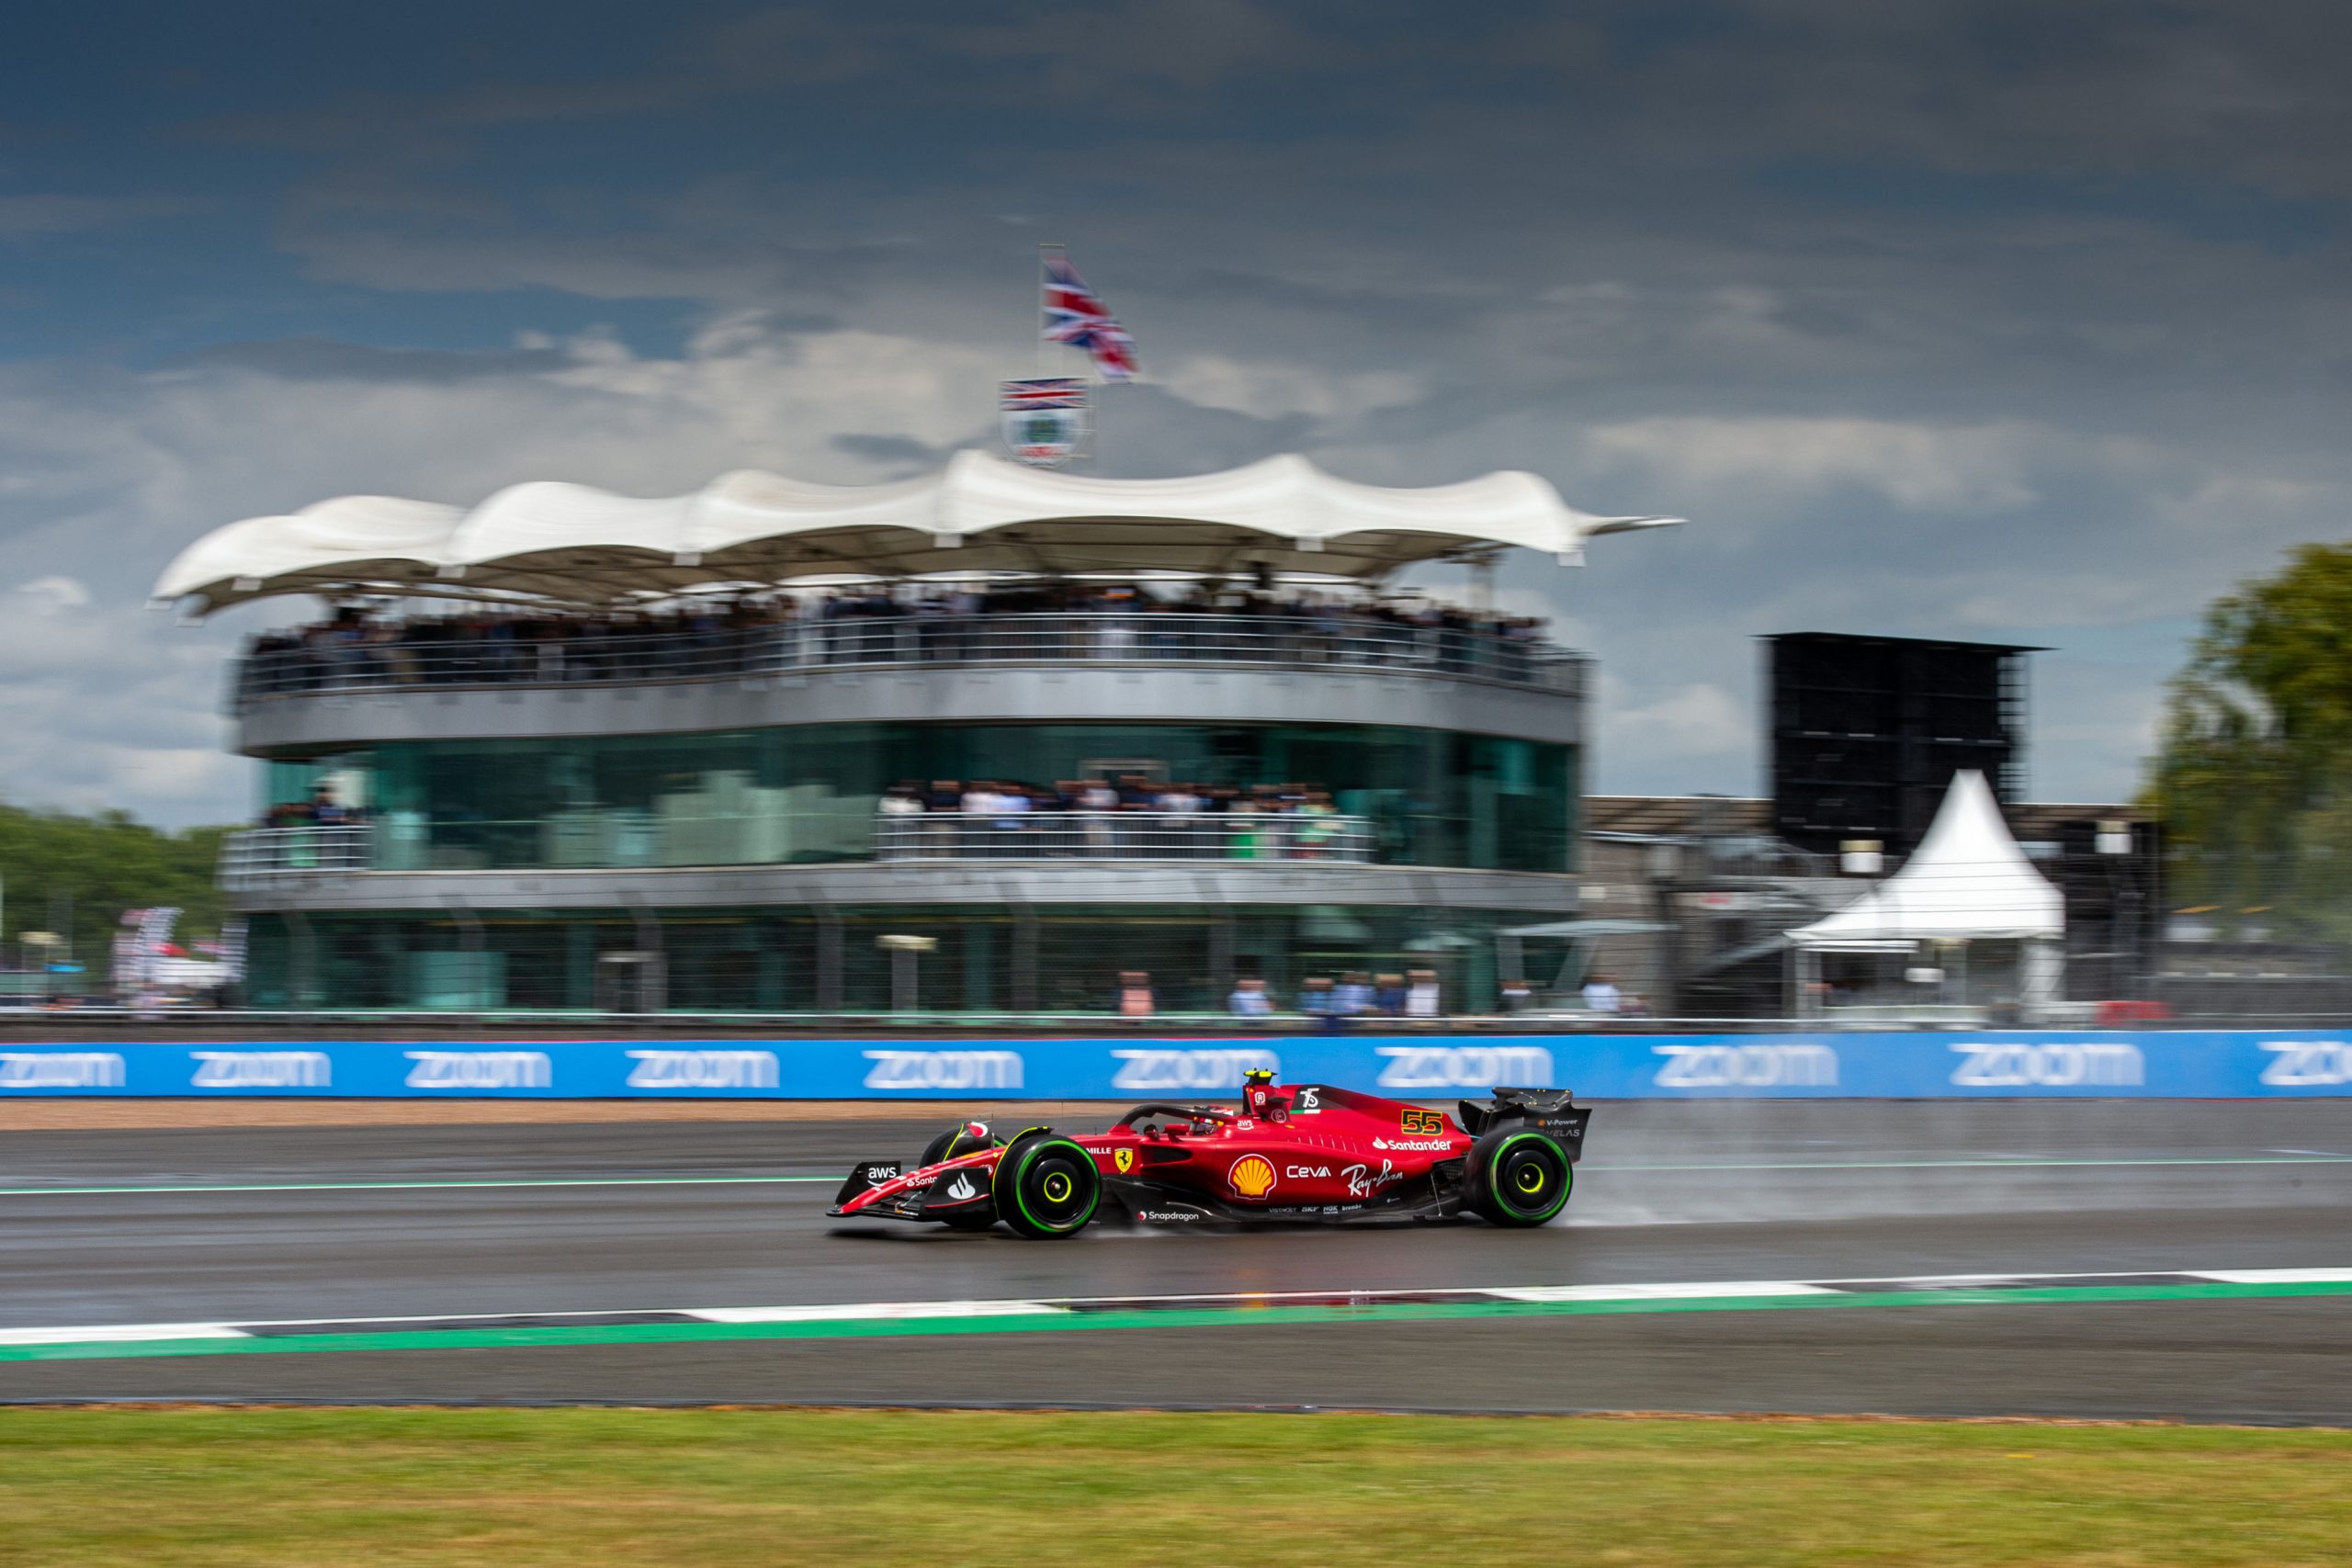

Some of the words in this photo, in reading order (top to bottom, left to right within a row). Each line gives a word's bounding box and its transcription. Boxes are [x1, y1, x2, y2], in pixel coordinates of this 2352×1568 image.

[190, 1052, 332, 1088] zoom
[404, 1052, 549, 1088] zoom
[626, 1051, 779, 1089] zoom
[863, 1050, 1023, 1089] zoom
[1110, 1049, 1281, 1089] zoom
[1375, 1046, 1555, 1088] zoom
[1652, 1044, 1838, 1087] zoom
[1949, 1043, 2145, 1086] zoom
[2257, 1042, 2352, 1086] zo
[1238, 1120, 1253, 1128] aws
[1401, 1109, 1443, 1136] 55
[1387, 1139, 1452, 1152] Santander
[867, 1167, 897, 1179] aws
[1340, 1159, 1403, 1198] Ray-Ban
[1148, 1212, 1199, 1222] Snapdragon
